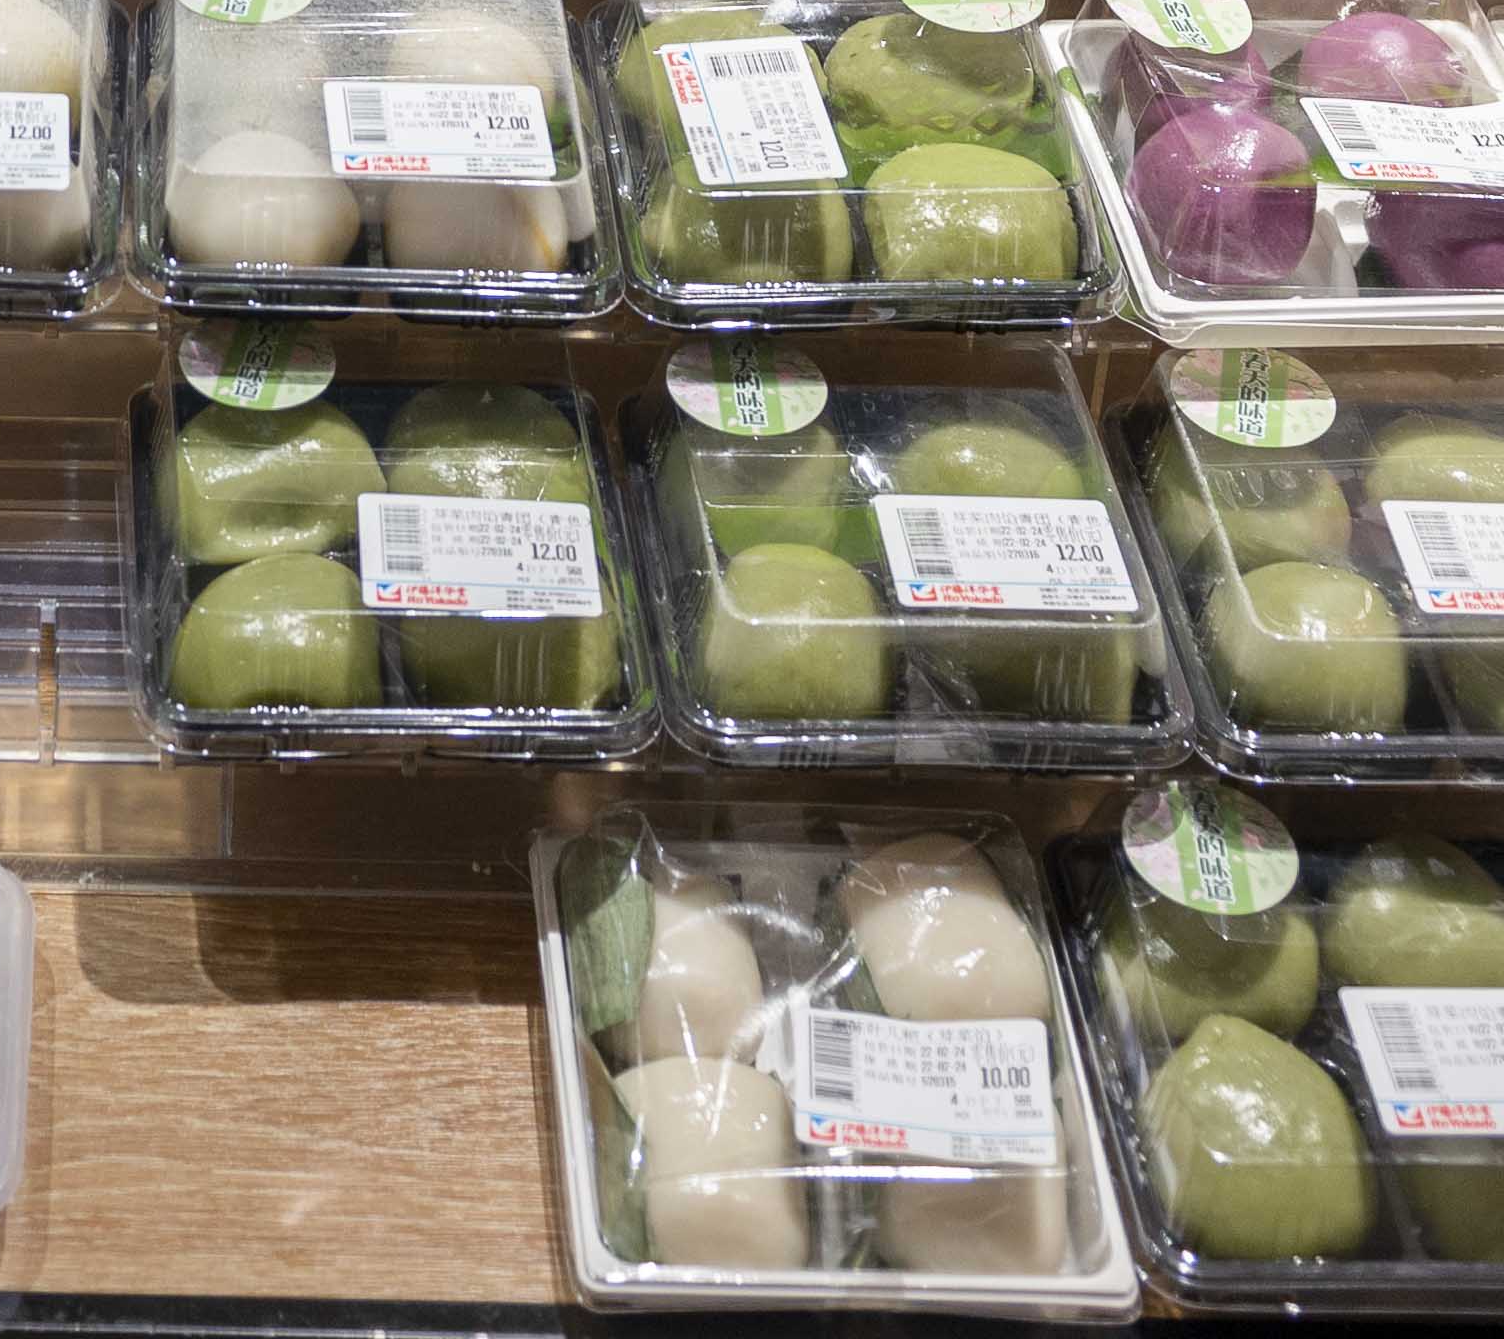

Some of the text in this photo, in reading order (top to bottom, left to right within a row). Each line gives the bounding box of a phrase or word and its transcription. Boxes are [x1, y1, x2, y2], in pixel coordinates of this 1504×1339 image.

[8, 125, 52, 140] 12.00
[486, 117, 530, 131] 12.00
[531, 543, 578, 562] 12.00
[1055, 544, 1104, 563] 12.00
[980, 1066, 1031, 1090] 10.00
